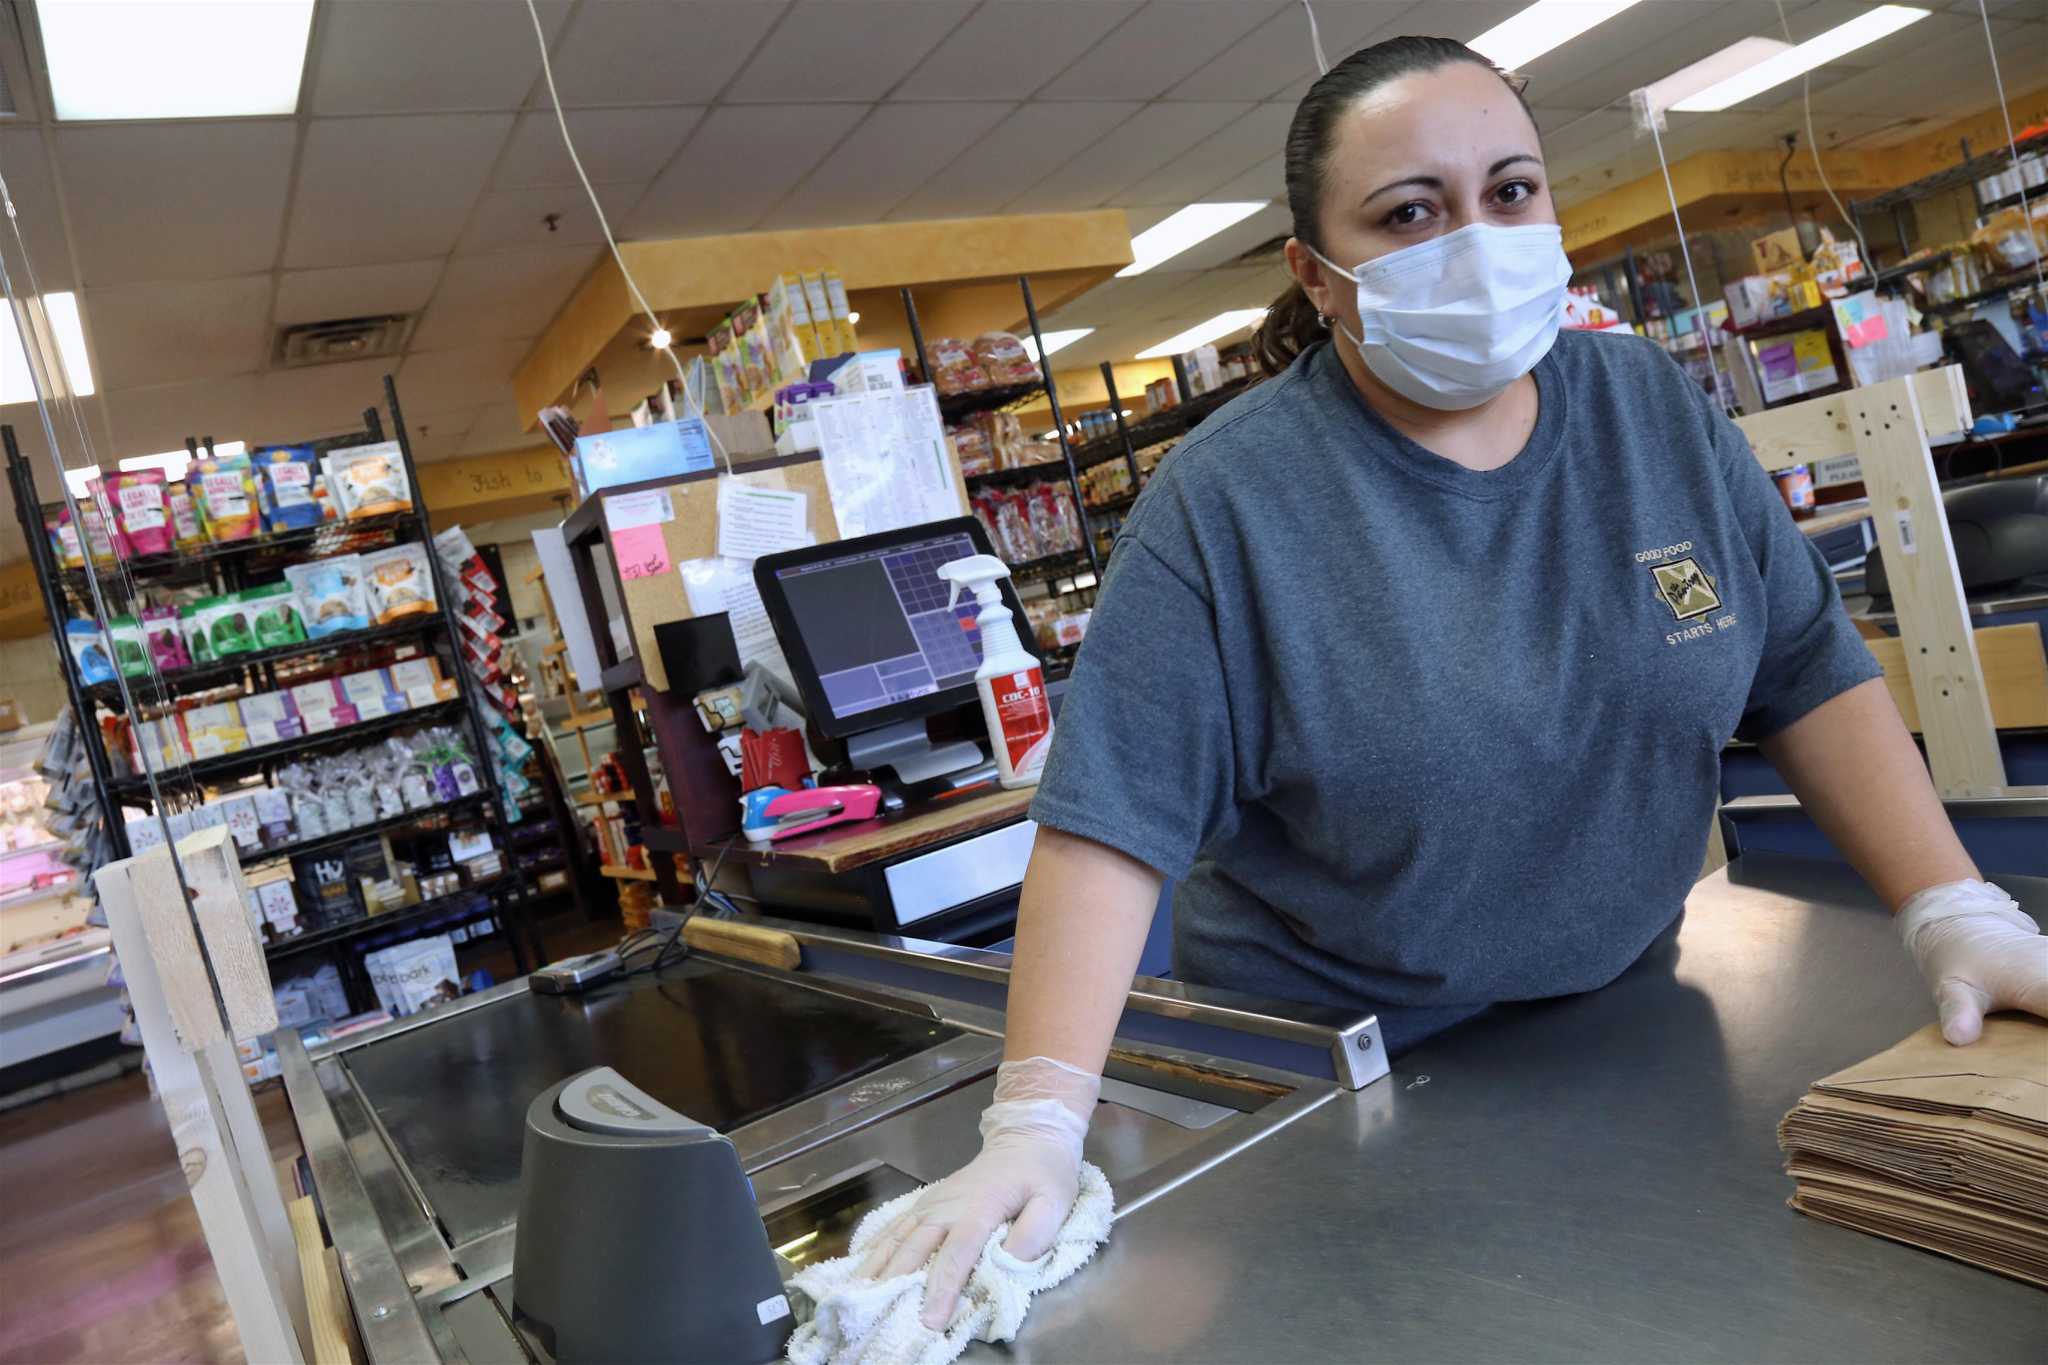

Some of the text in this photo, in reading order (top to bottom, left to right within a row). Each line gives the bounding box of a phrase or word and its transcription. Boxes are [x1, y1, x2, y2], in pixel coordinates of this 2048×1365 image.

[1635, 541, 1692, 562] GOOD FOOD
[1666, 622, 1714, 645] STARTS
